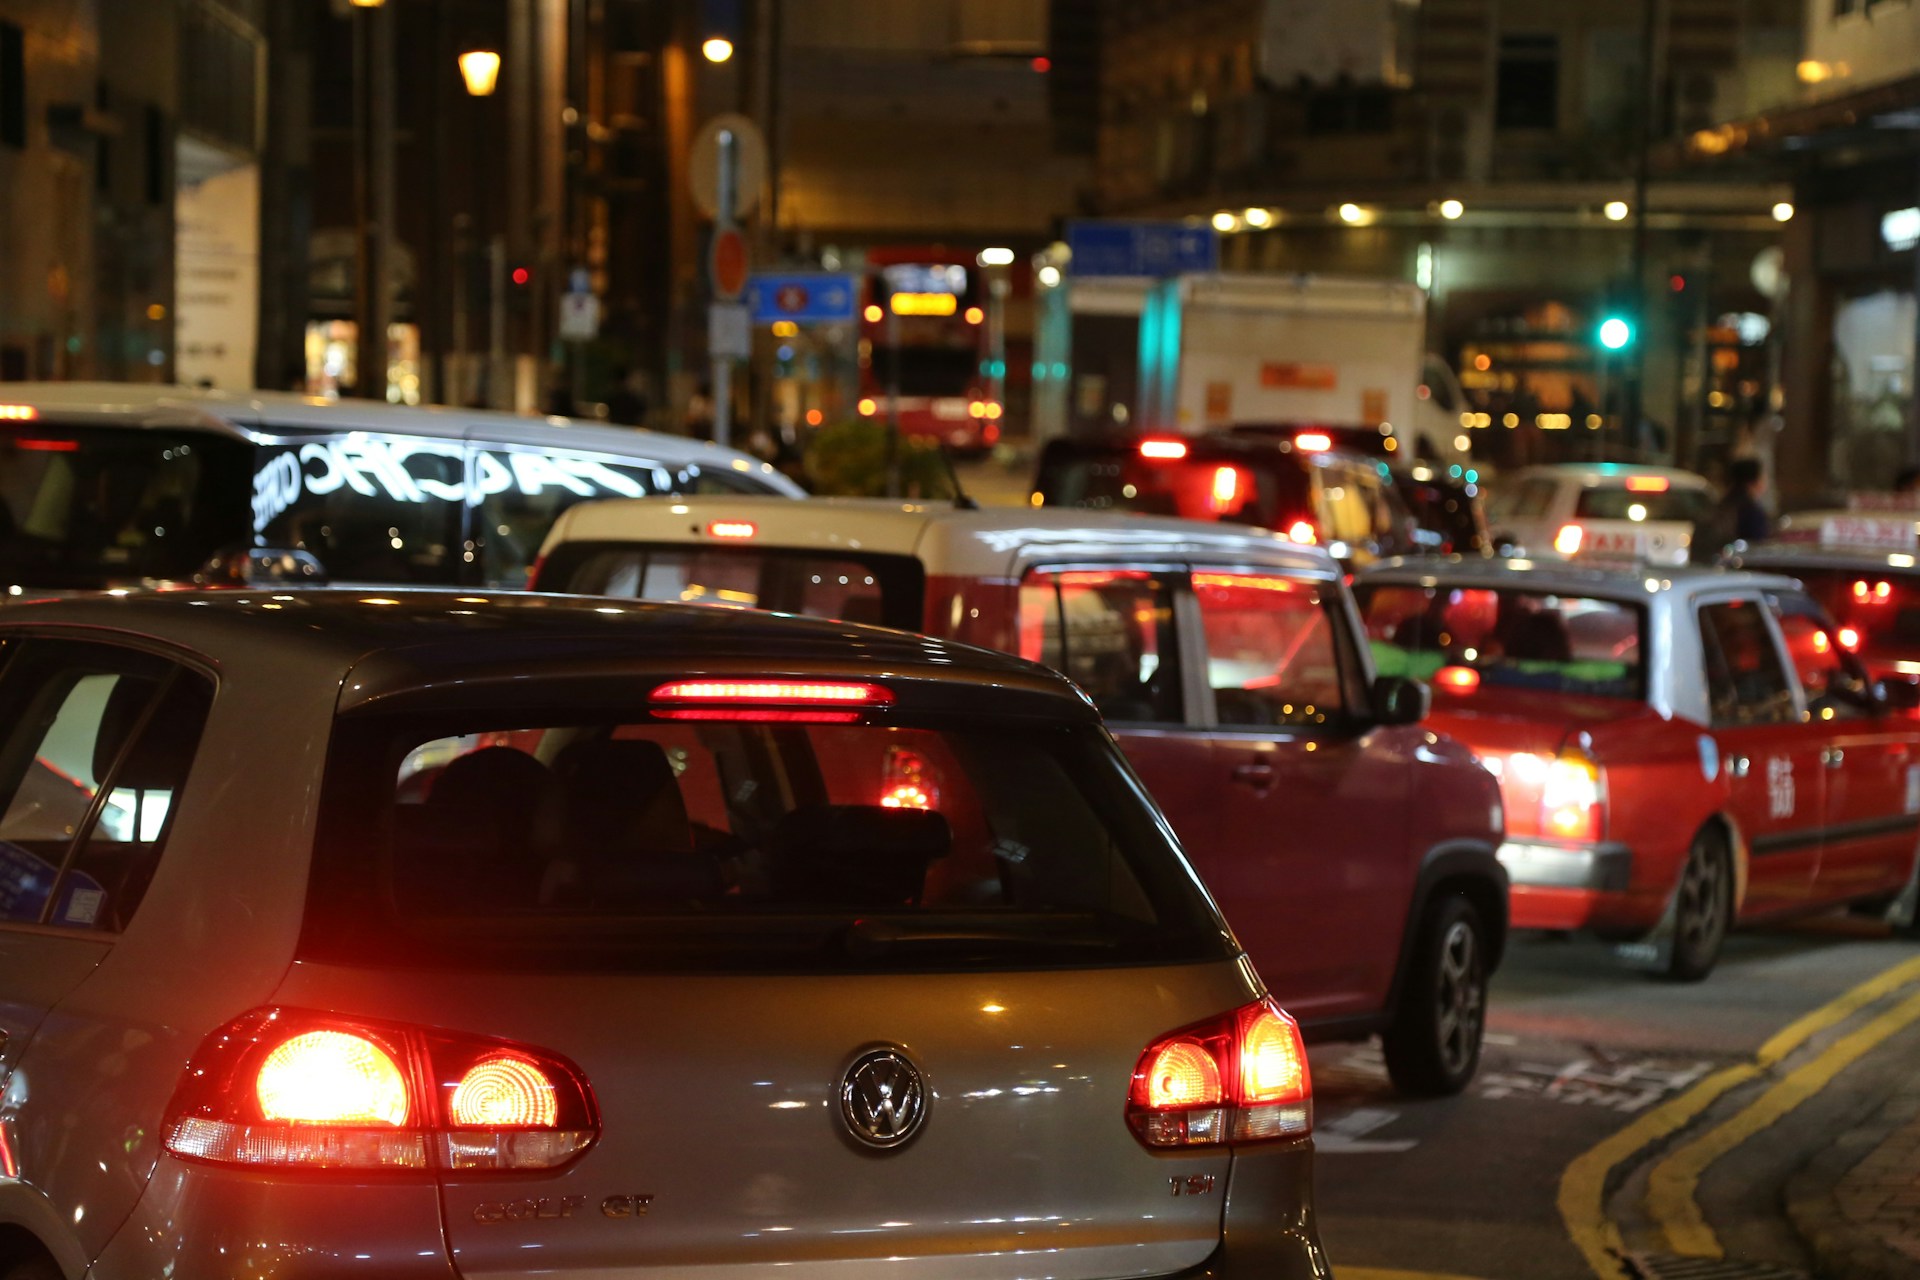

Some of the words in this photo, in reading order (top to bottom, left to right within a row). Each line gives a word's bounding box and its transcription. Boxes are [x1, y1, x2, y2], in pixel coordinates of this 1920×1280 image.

[1168, 1173, 1216, 1197] TSI
[473, 1194, 588, 1225] GOLF
[600, 1194, 655, 1219] GT
